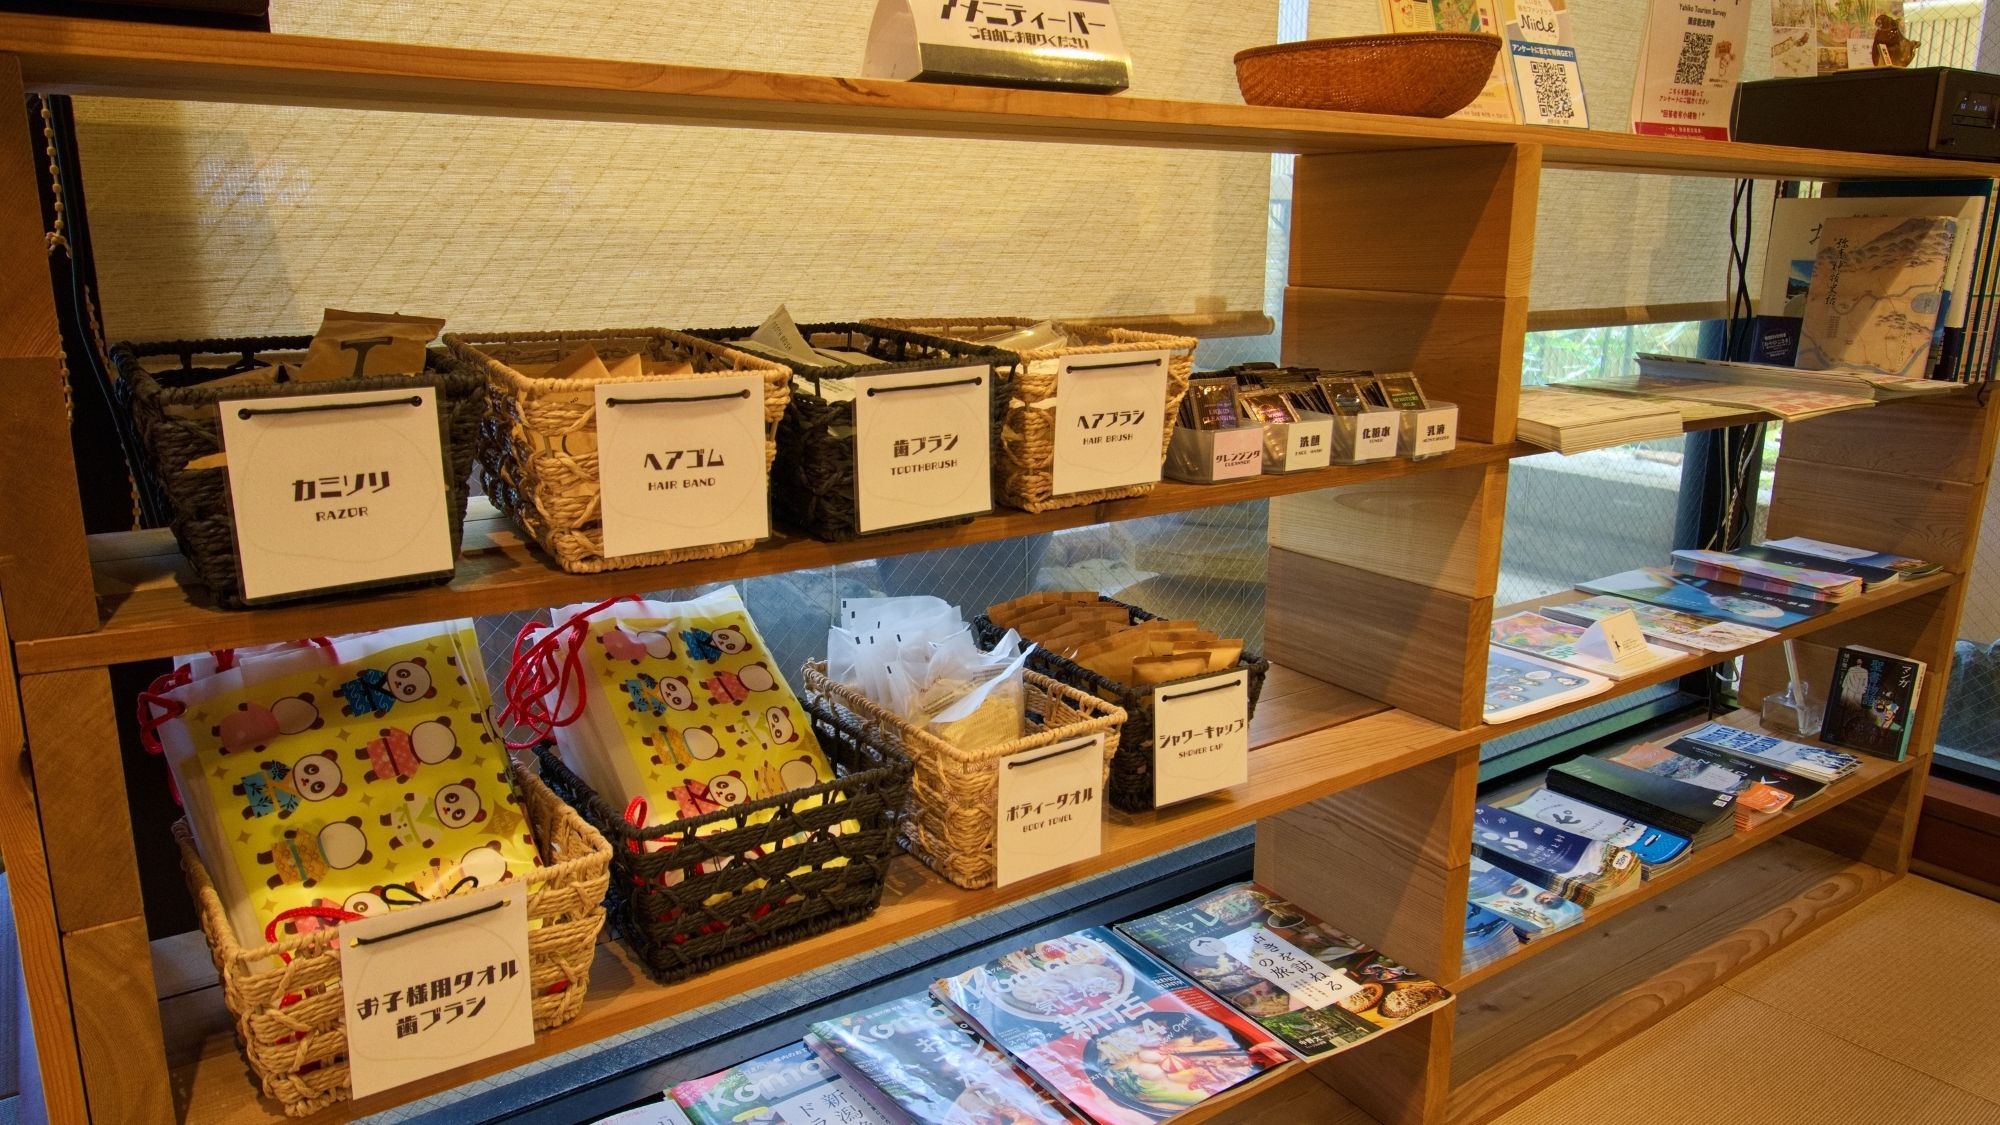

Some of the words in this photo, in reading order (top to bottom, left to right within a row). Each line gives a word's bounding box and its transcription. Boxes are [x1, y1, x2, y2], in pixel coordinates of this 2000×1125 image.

[1679, 4, 1694, 12] Yahiko
[1712, 8, 1727, 18] Survey
[1521, 14, 1555, 33] Niicle
[968, 26, 1090, 49] ご自由にお取りください
[1077, 409, 1145, 430] ヘアブラシ
[1427, 423, 1446, 436] 乳液
[1083, 437, 1102, 446] HAIR
[1106, 432, 1133, 443] BRUSH
[1300, 434, 1321, 448] 洗顔
[1362, 426, 1391, 440] 化粧水
[893, 434, 958, 458] 歯ブラシ
[644, 449, 725, 471] ヘアゴム
[890, 459, 957, 476] TOOTHBRUSH
[291, 471, 391, 502] カミソリ
[648, 480, 678, 491] HAIR
[683, 477, 716, 489] BAND
[316, 507, 368, 522] RAZOR
[1898, 665, 1912, 688] マンガ
[1159, 718, 1244, 749] シャワーキャップ
[1178, 747, 1208, 759] SHOWER
[1209, 743, 1224, 752] CAP
[1022, 820, 1045, 833] BODY
[1048, 813, 1073, 826] TOWEL
[1138, 898, 1251, 943] キャレル
[356, 959, 519, 1020] お子様用タオル
[396, 996, 486, 1039] 歯ブラシ
[1053, 991, 1153, 1041] 新店
[1172, 1013, 1192, 1031] Open!
